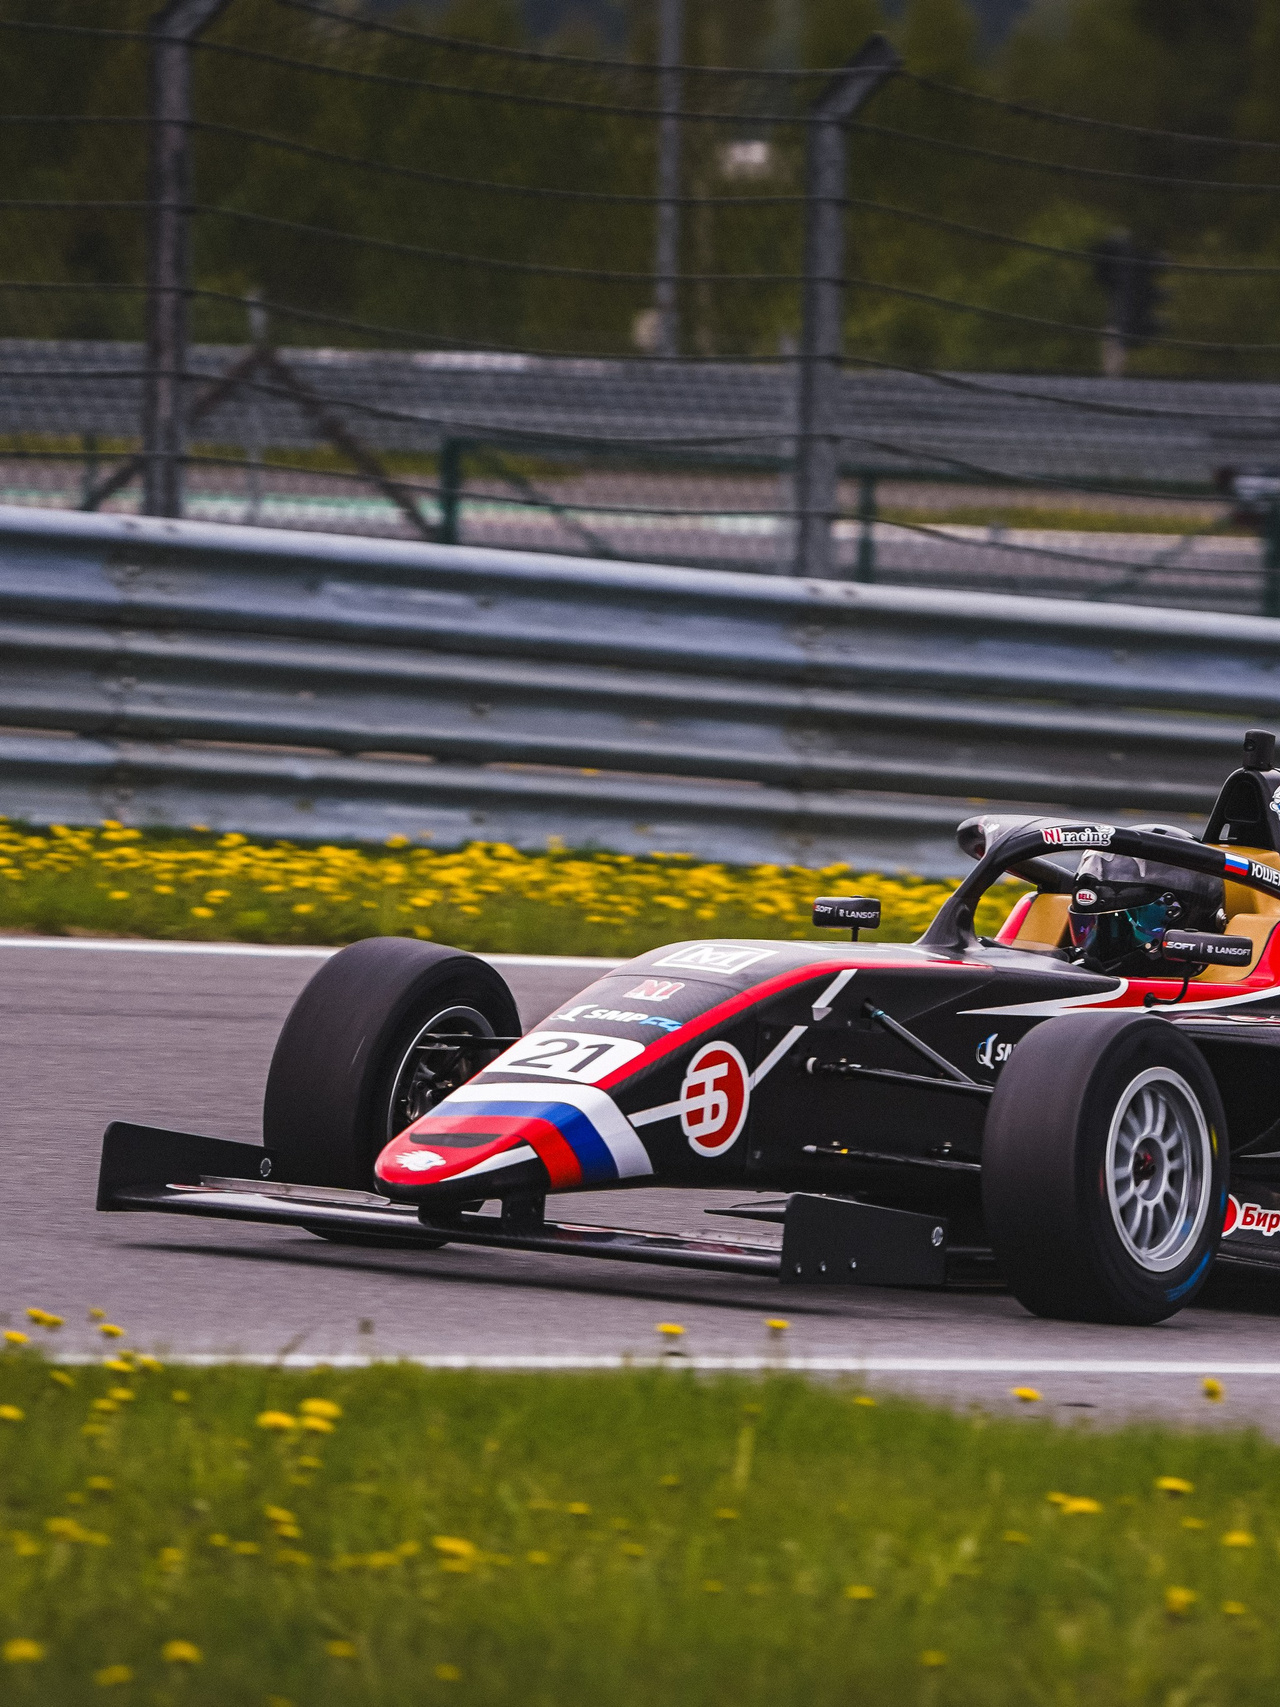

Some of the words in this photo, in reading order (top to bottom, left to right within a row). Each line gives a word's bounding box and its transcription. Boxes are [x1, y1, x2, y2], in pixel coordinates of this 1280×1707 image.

[845, 910, 880, 919] LANSOFT
[1215, 946, 1251, 956] LANSOFT
[507, 1038, 615, 1073] 21
